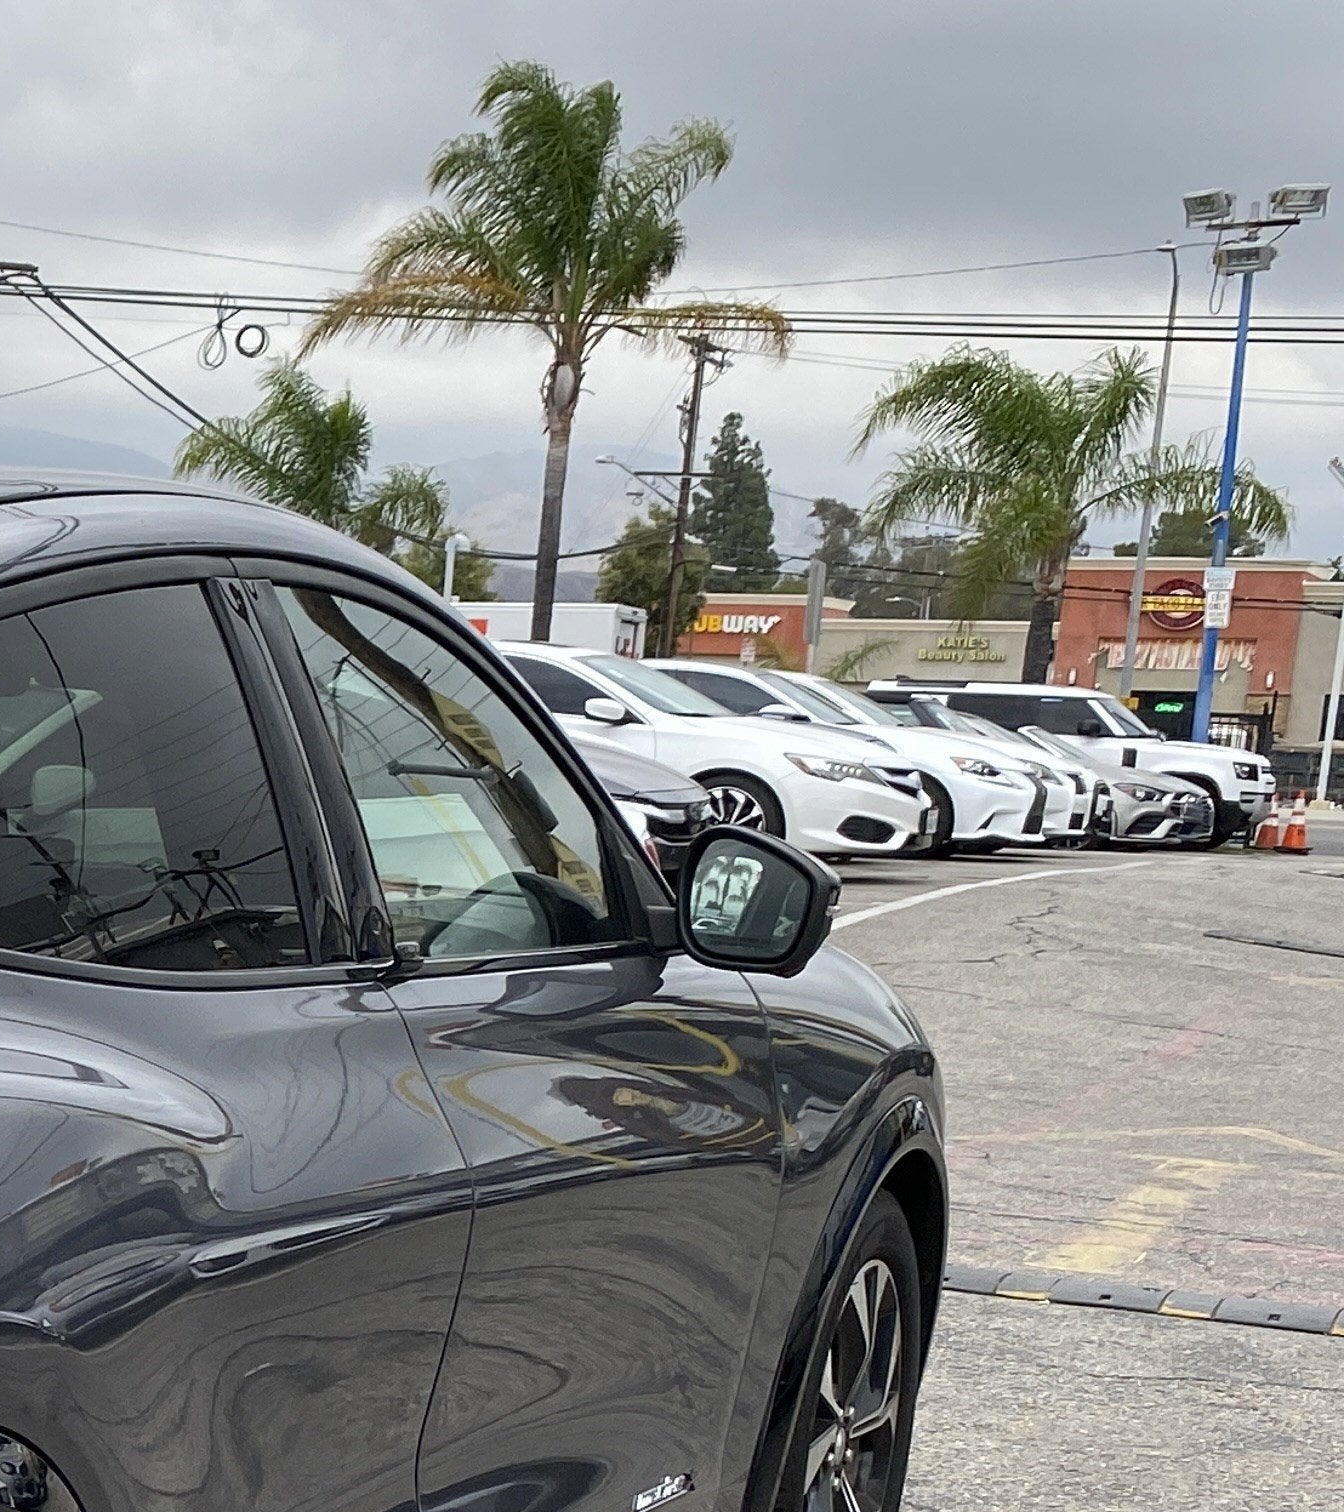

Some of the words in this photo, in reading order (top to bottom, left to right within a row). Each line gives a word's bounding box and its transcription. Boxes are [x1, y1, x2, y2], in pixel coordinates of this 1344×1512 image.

[686, 614, 782, 634] UBWAY
[937, 636, 989, 648] KATIE'S
[917, 648, 964, 663] Beauty
[968, 649, 1006, 661] Salon
